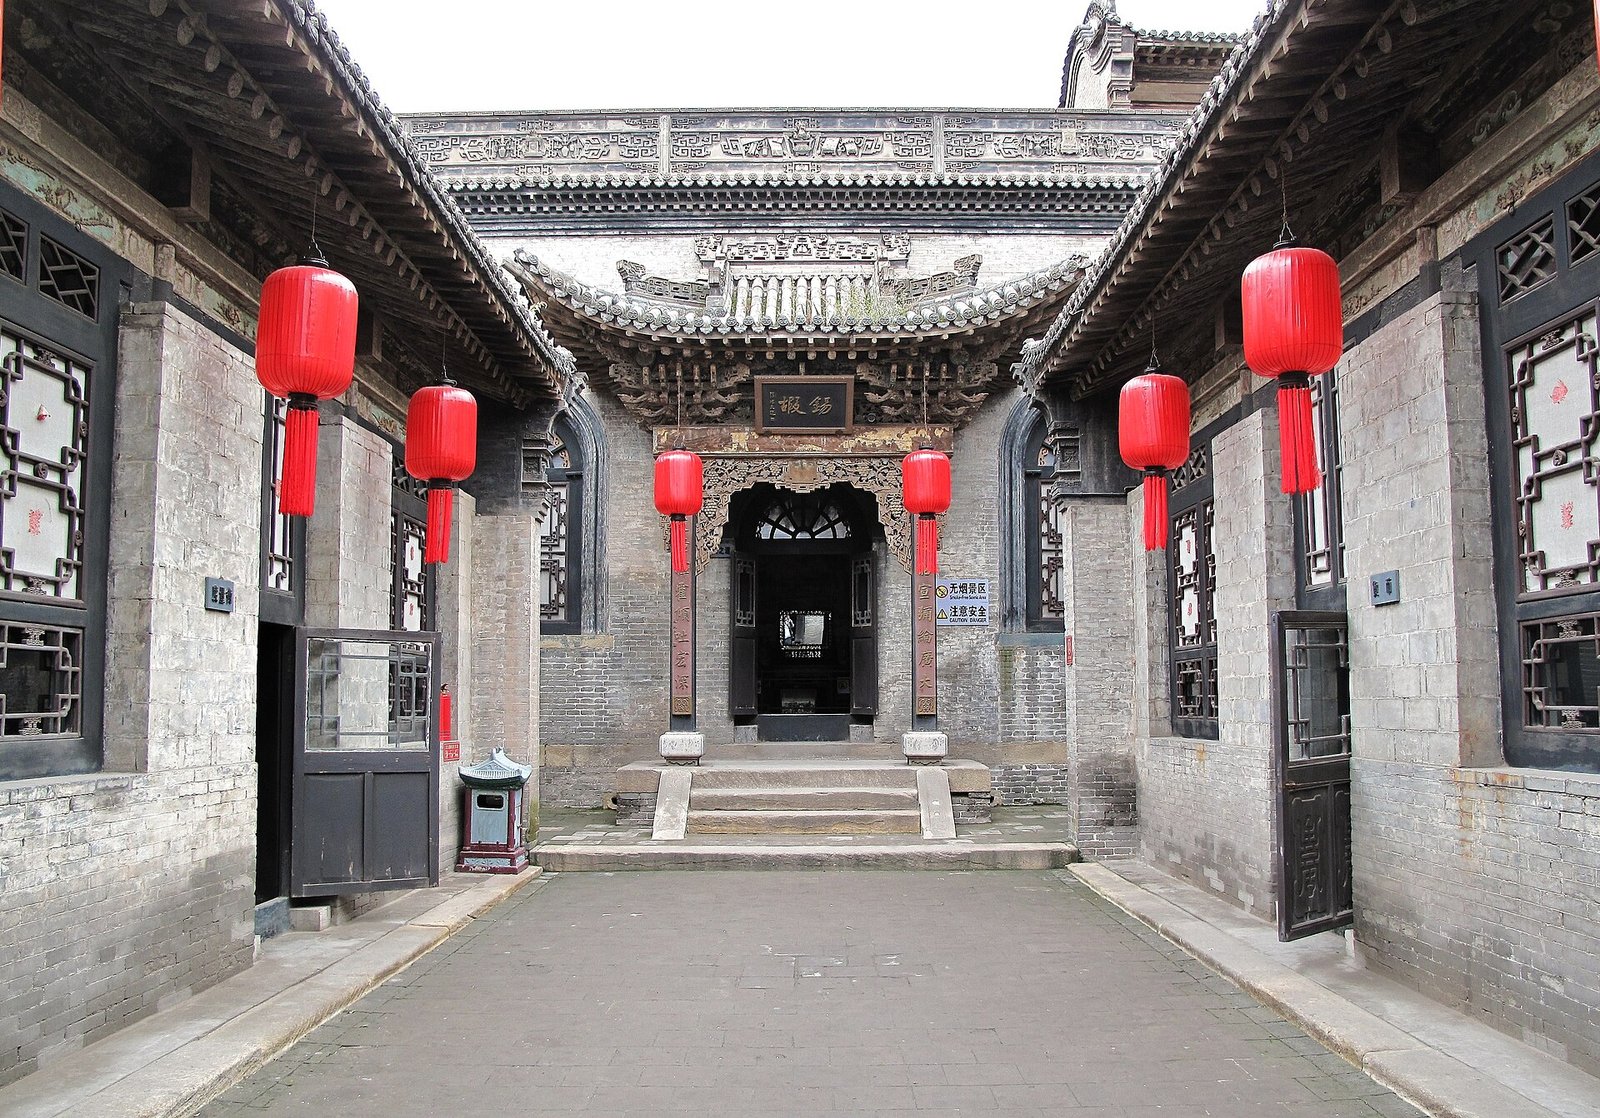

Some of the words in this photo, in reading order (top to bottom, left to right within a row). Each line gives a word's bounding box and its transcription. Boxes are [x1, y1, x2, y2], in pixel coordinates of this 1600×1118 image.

[950, 582, 986, 594] 无烟景区
[950, 605, 986, 617] 注意安全
